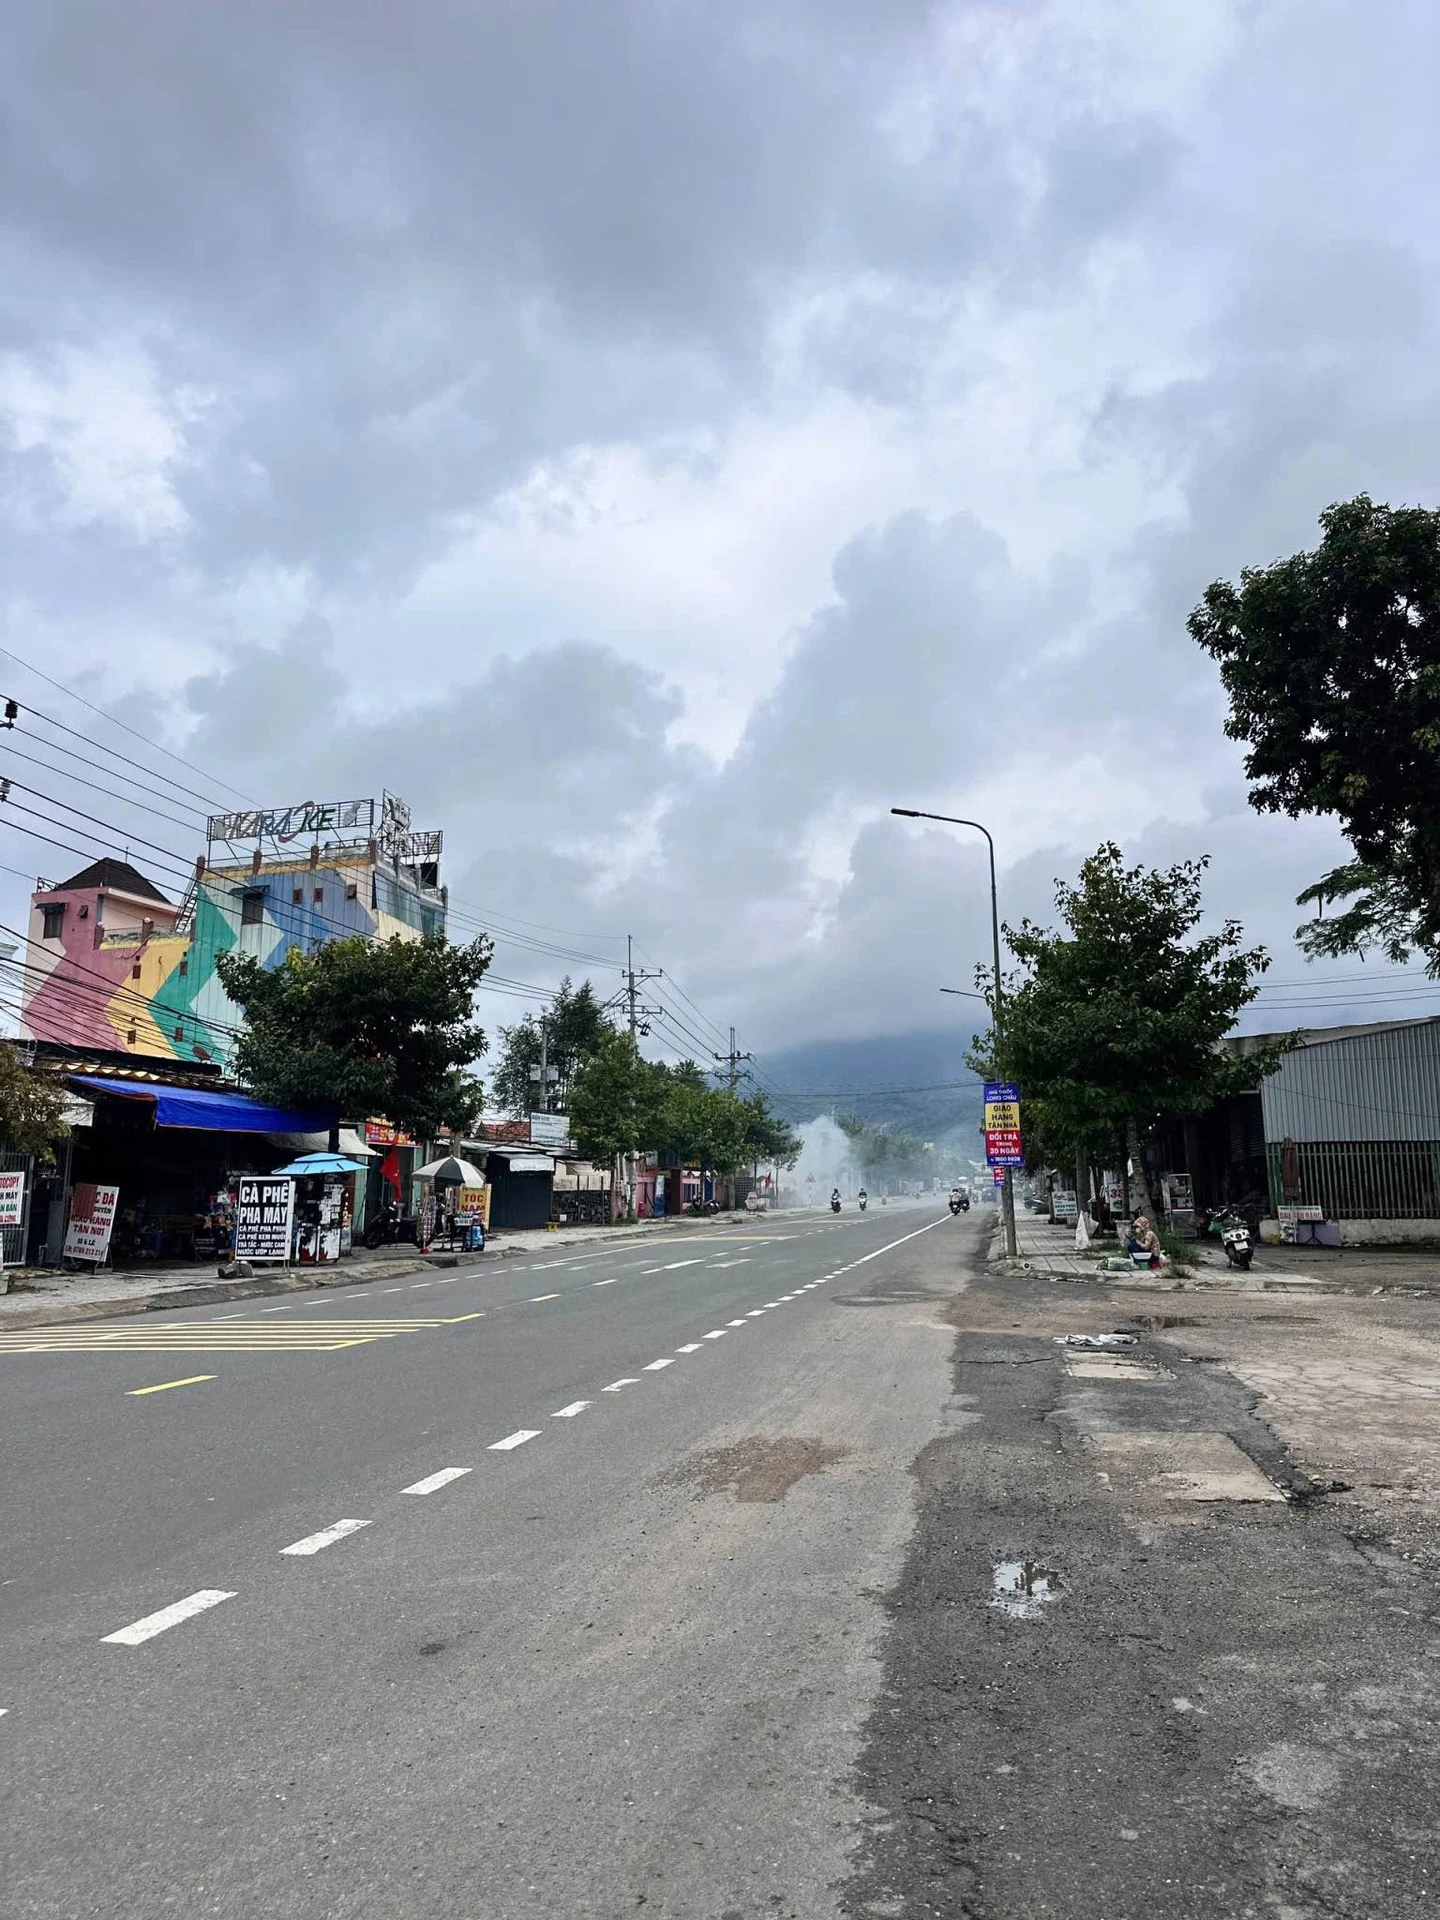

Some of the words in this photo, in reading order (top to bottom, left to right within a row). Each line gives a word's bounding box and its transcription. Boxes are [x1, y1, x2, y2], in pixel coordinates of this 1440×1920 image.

[241, 1183, 259, 1204] CÀ
[262, 1182, 289, 1204] PHÊ
[240, 1207, 260, 1224] PHA
[263, 1203, 288, 1224] MÁY
